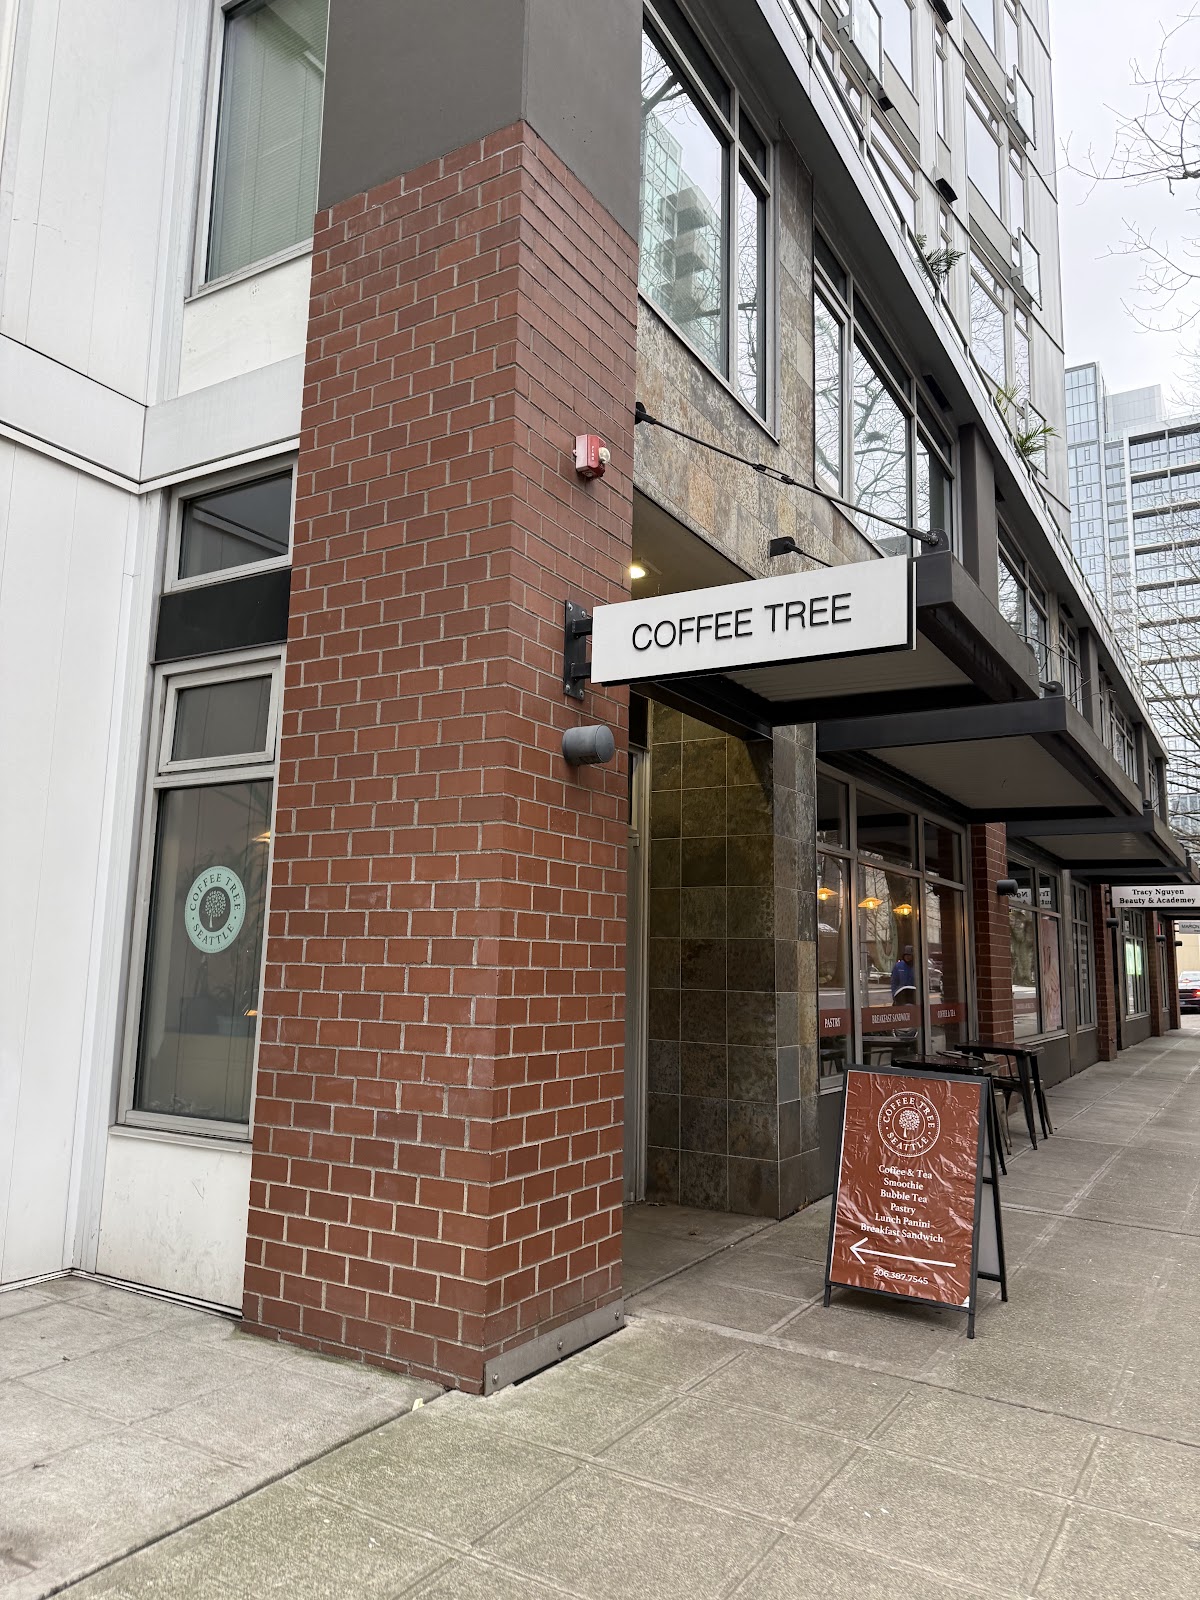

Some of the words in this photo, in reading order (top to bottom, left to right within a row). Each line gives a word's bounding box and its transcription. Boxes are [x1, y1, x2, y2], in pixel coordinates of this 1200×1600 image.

[632, 607, 753, 651] COFFEE
[764, 592, 852, 633] TREE
[190, 873, 221, 911] COFFEE
[225, 876, 241, 911] TREE
[1132, 888, 1153, 896] Tracy
[1155, 888, 1185, 896] Nguyen
[1119, 897, 1146, 905] Beauty
[1156, 896, 1196, 904] Academey
[193, 923, 235, 946] SEATTLE
[824, 1017, 842, 1028] PASTRY
[883, 1097, 915, 1123] COFFEE
[919, 1100, 936, 1129] TREE
[886, 1132, 929, 1151] SEATTLE
[878, 1164, 906, 1176] Coffee
[907, 1169, 915, 1177] &
[916, 1169, 933, 1180] Tea
[883, 1178, 924, 1190] Smoothie
[880, 1188, 910, 1201] Bubble
[912, 1194, 928, 1204] Tea
[890, 1203, 916, 1216] Pastry
[875, 1213, 901, 1225] Lunch
[903, 1217, 931, 1229] Panini
[860, 1222, 900, 1236] Breakfast
[901, 1229, 943, 1243] Sandwich
[873, 1267, 929, 1285] 206.387.7545
